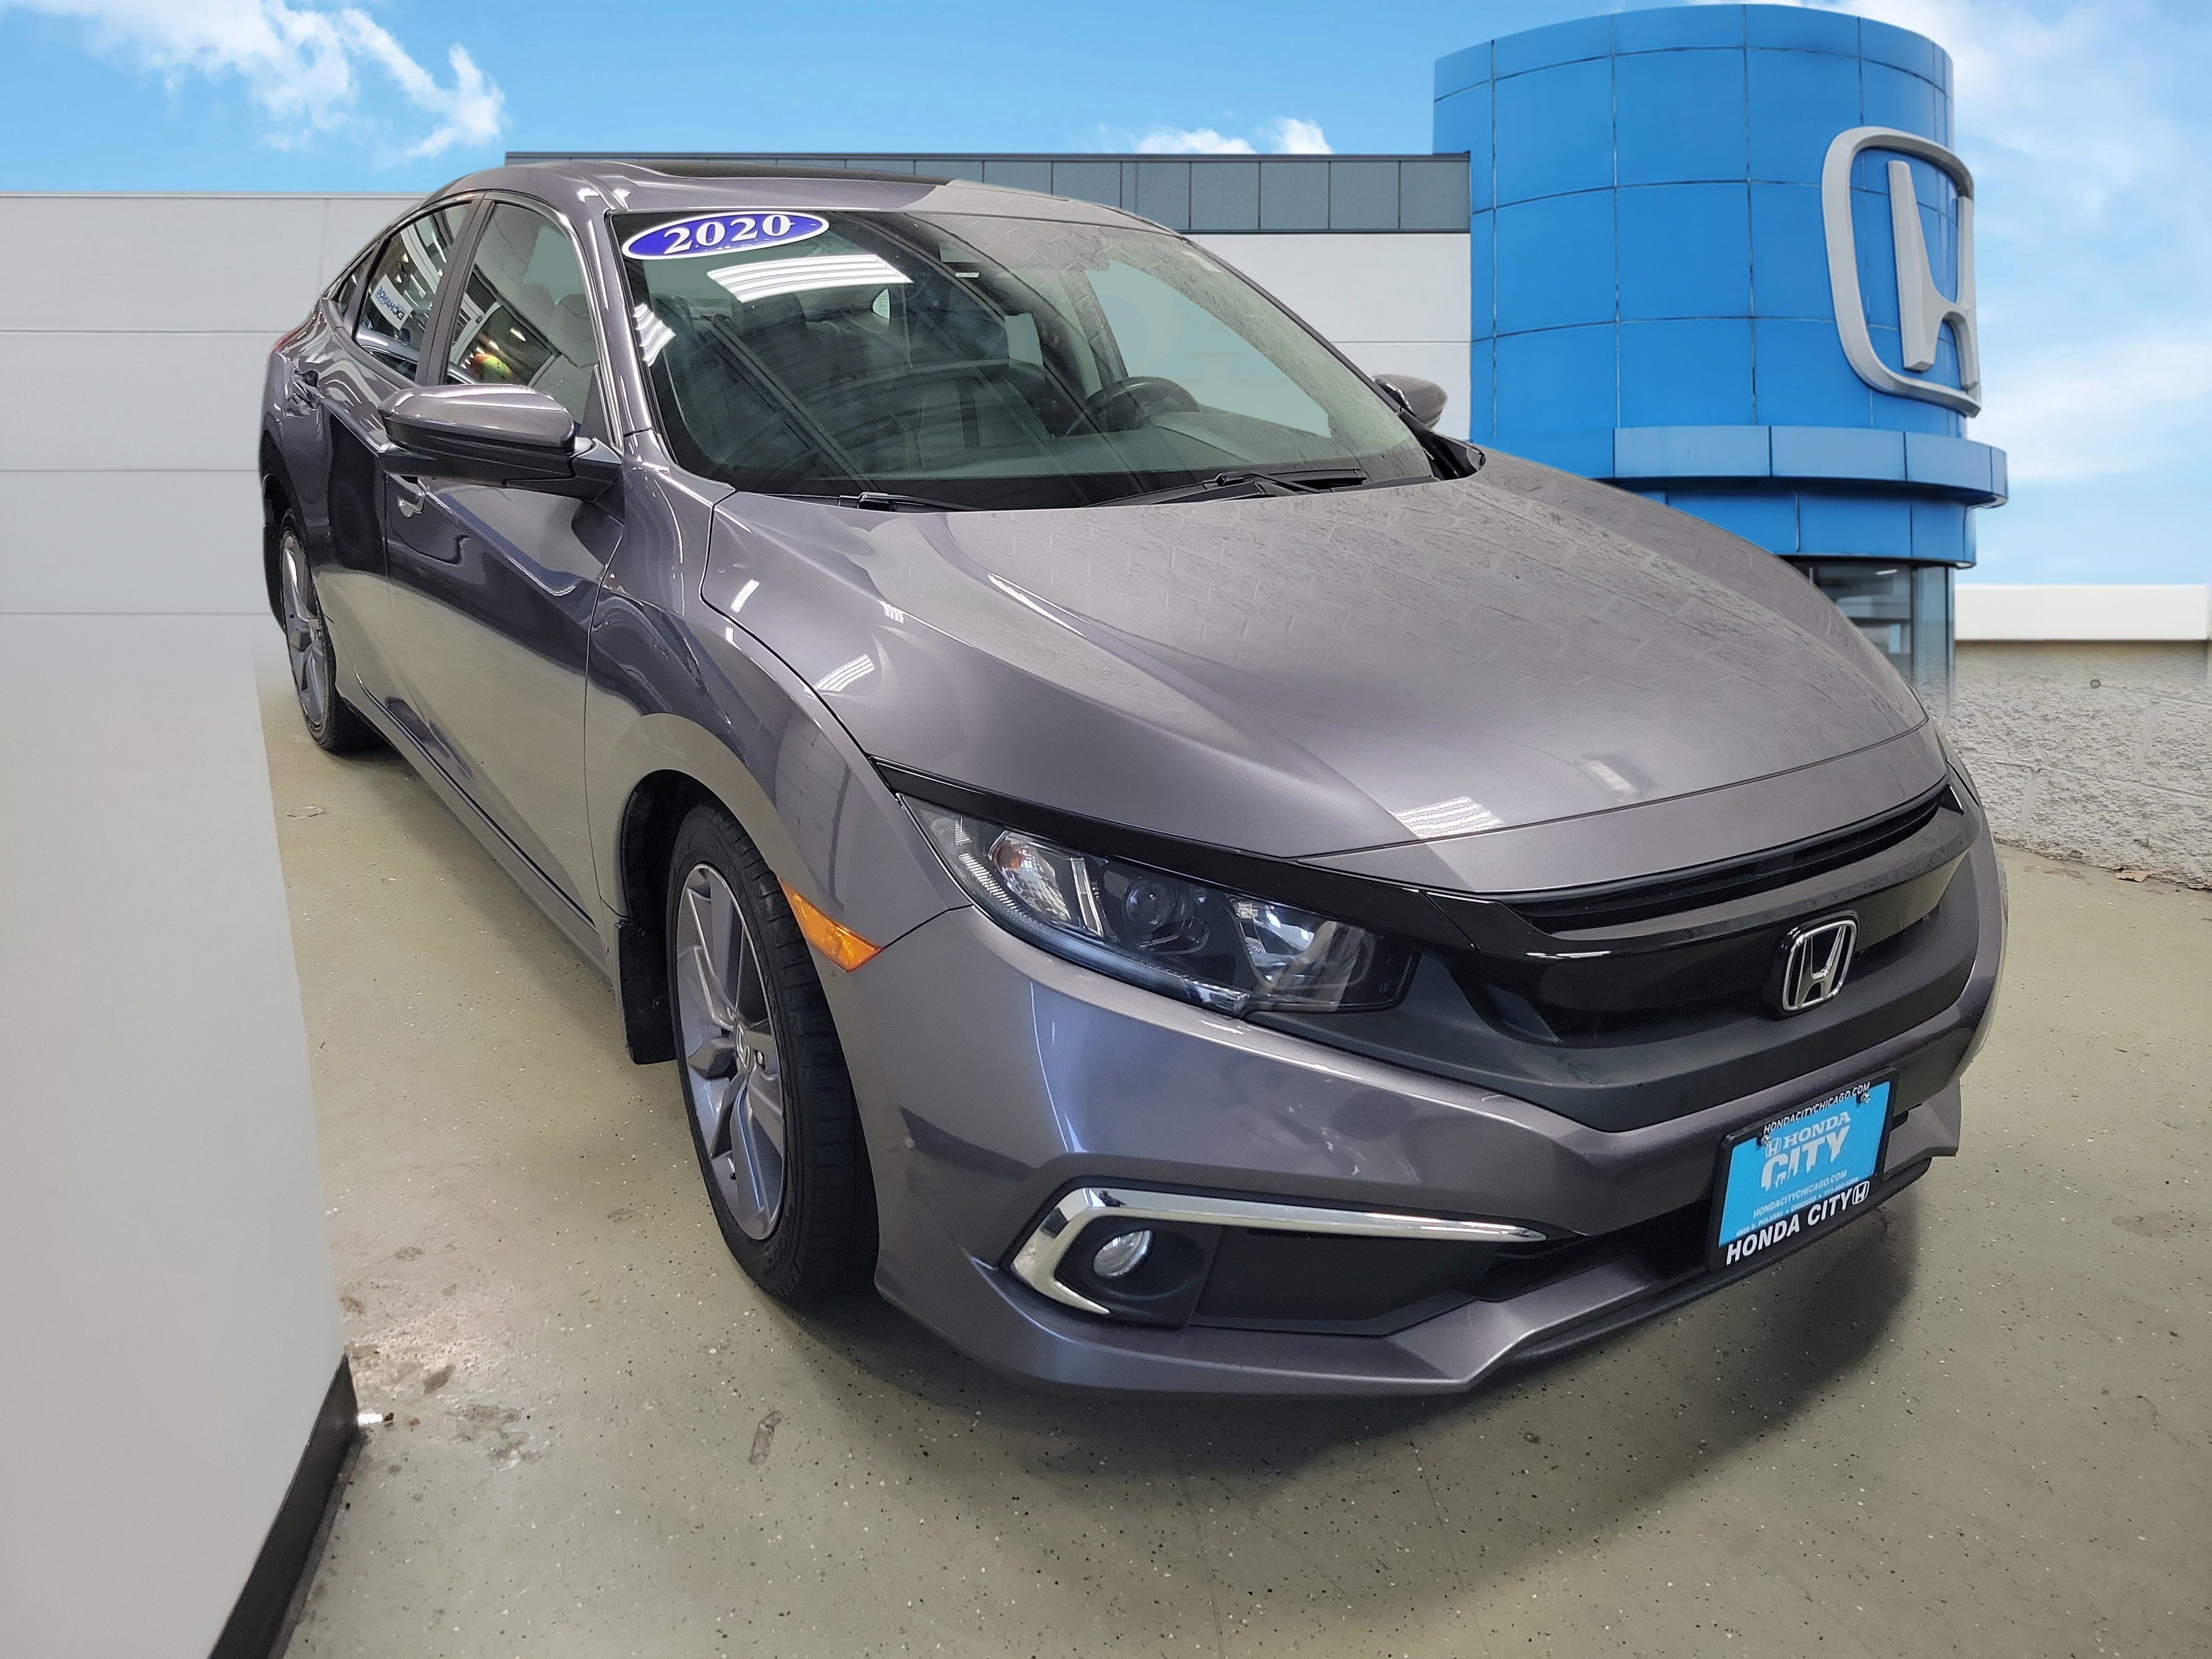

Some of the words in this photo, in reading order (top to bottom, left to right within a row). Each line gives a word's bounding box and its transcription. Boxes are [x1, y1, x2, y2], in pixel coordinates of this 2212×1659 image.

[663, 215, 791, 255] 2020
[1763, 1081, 1870, 1135] HONDACITYCHICAGO.COM
[1784, 1110, 1851, 1149] HONDA
[1761, 1125, 1850, 1193] CITY
[1753, 1169, 1848, 1218] HONDACITYCHICAGO.COM
[1726, 1214, 1800, 1266] HONDA
[1808, 1188, 1853, 1226] CITY
